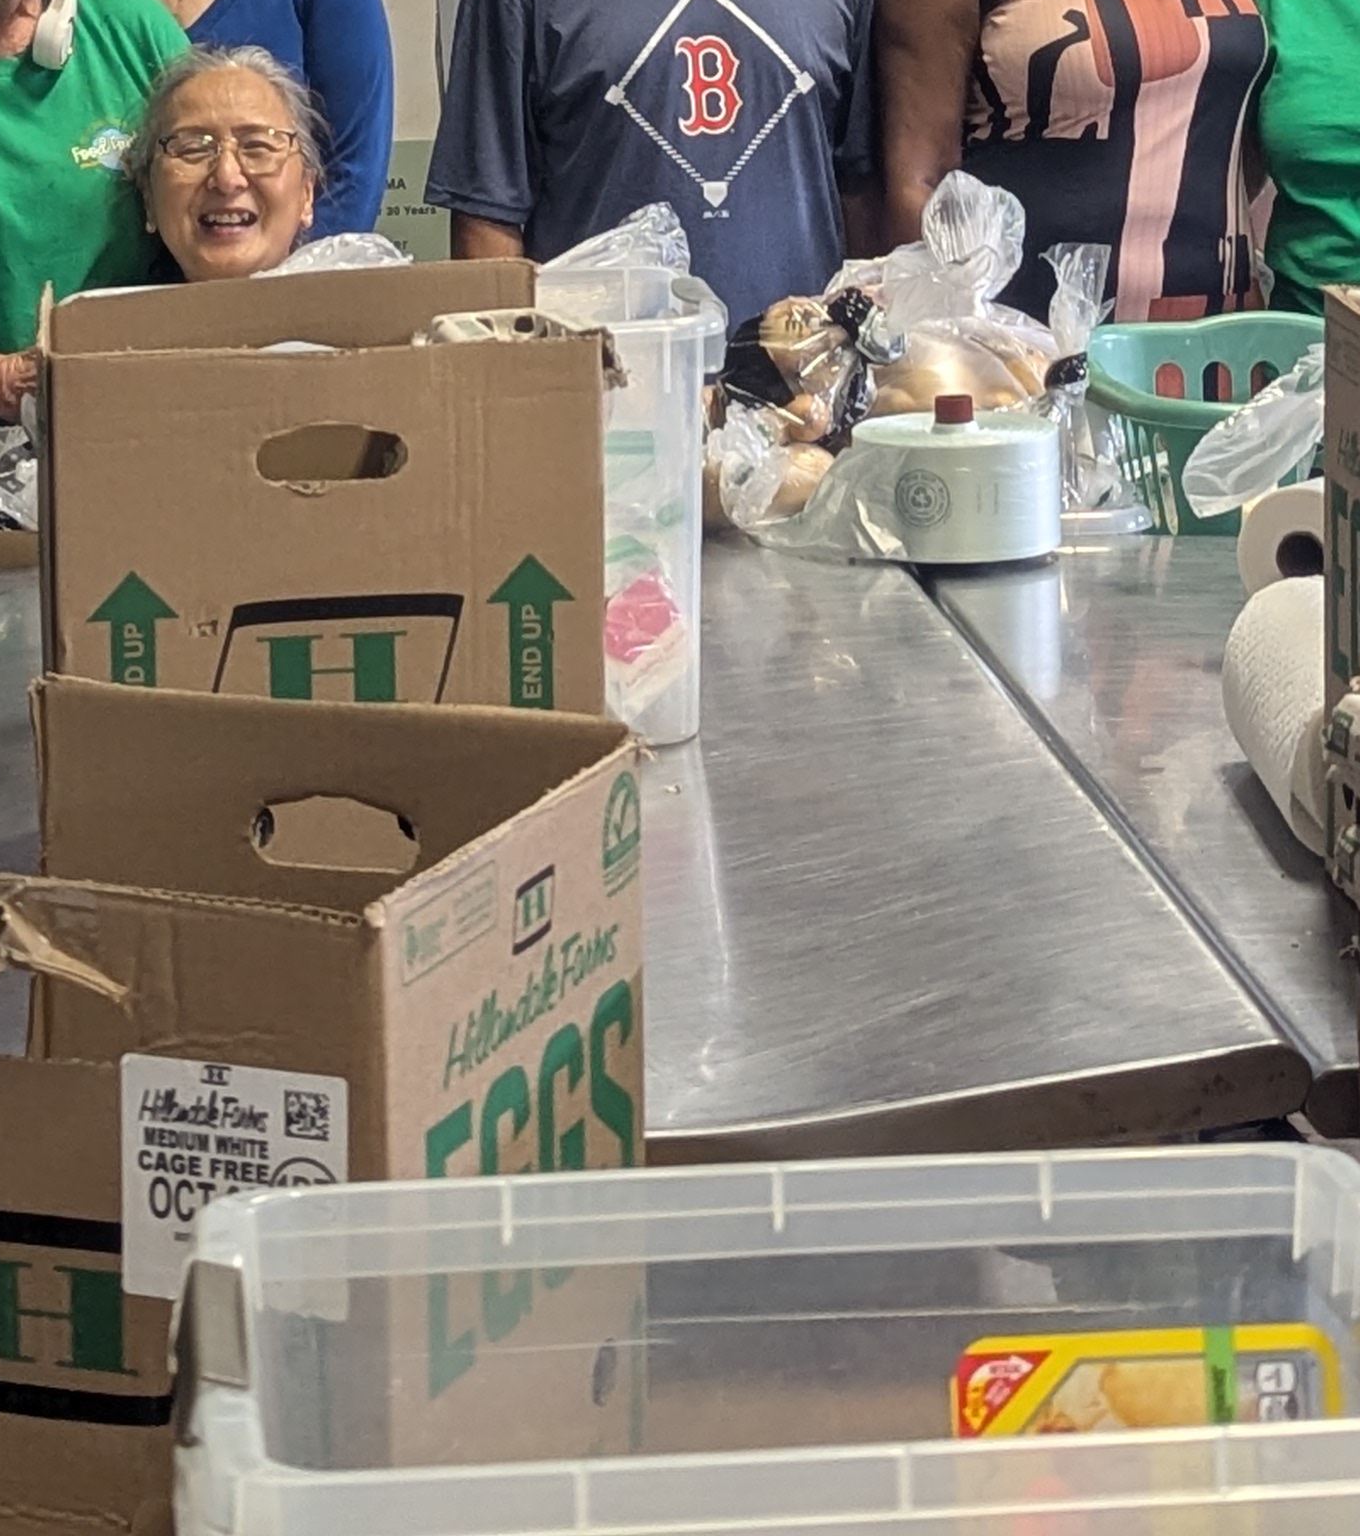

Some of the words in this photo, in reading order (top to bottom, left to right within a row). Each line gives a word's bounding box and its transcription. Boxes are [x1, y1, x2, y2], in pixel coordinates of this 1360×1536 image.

[674, 35, 743, 137] B
[403, 205, 437, 216] Years
[123, 622, 147, 658] UP
[521, 603, 543, 644] UP
[522, 647, 542, 700] END
[143, 1126, 210, 1153] MEDIUM
[215, 1136, 270, 1160] WHITE
[137, 1150, 203, 1177] CAGE
[210, 1157, 270, 1185] FREE
[148, 1176, 216, 1222] OCT
